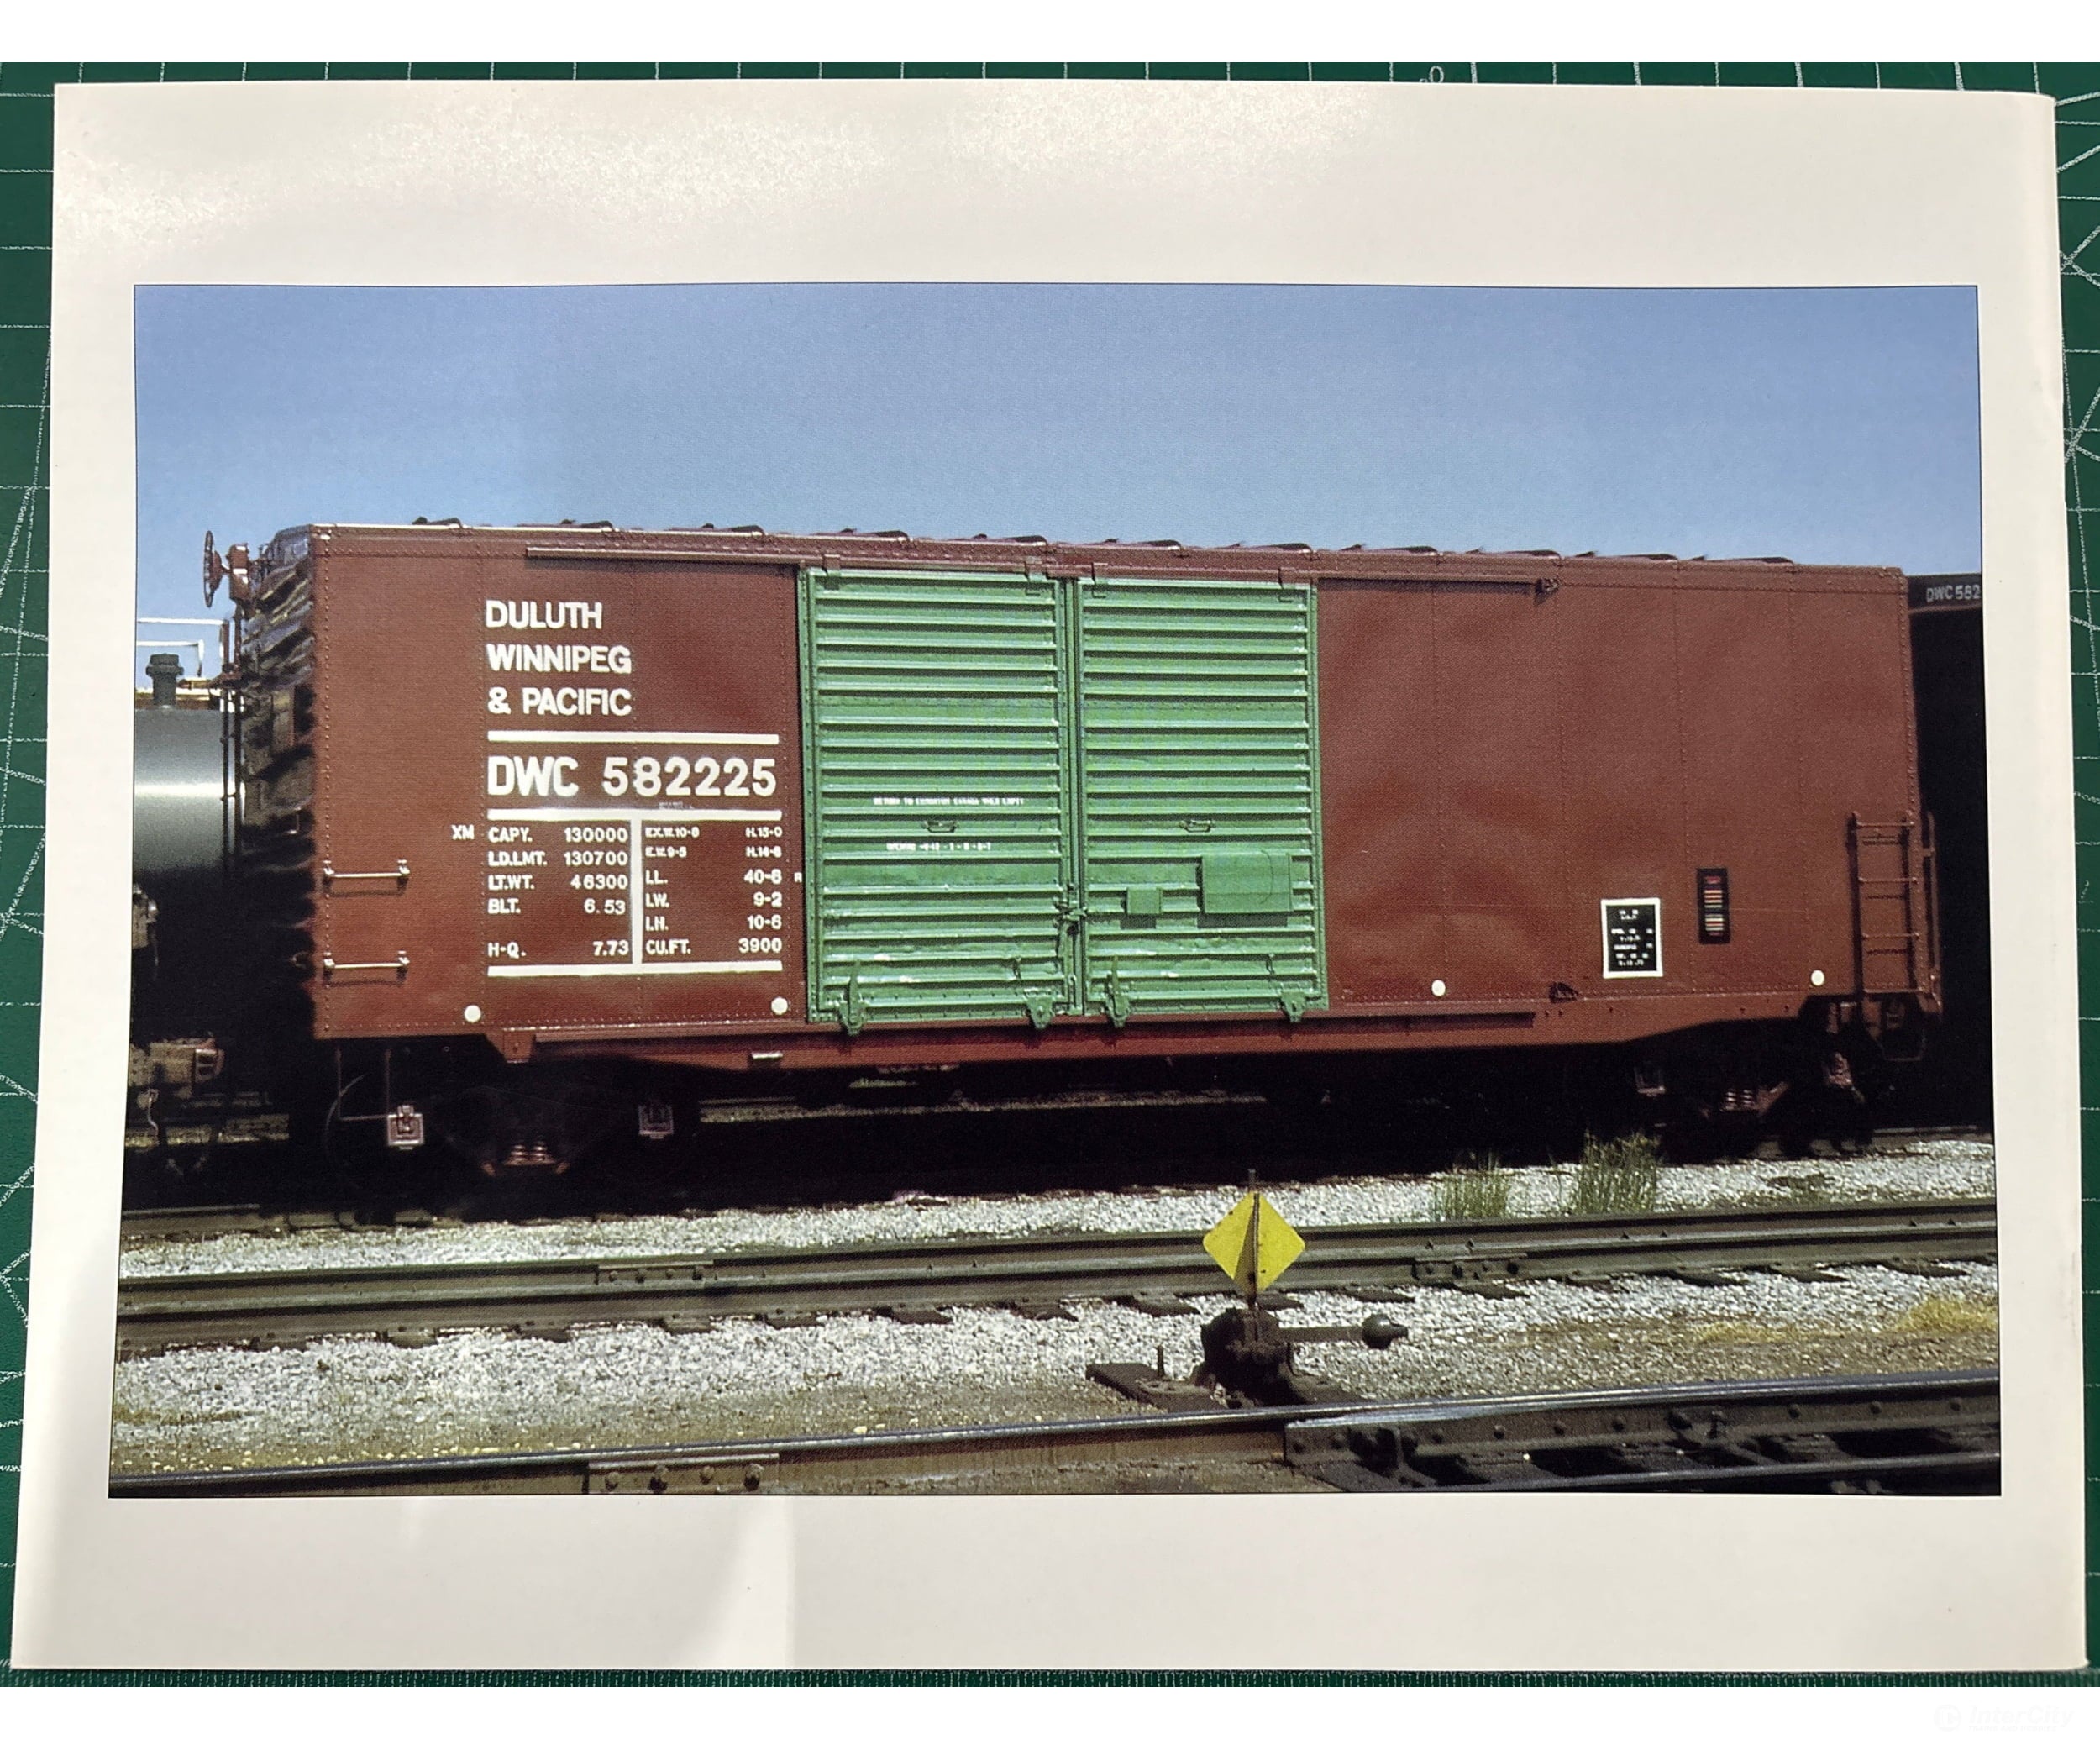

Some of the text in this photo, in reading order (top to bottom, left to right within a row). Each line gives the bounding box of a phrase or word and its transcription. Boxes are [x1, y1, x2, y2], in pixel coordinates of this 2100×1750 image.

[485, 599, 603, 629] DULUTH
[485, 644, 633, 675] WINNIPEG
[486, 686, 633, 716] & PACIFIC
[486, 755, 777, 797] DWC 582225
[450, 824, 475, 840] XM
[486, 826, 629, 843] CAPY. 130000
[563, 849, 629, 866] 130700
[487, 873, 629, 891] LT.WT. 46300
[486, 897, 522, 915] BLT.
[753, 891, 783, 908] 9-2
[592, 939, 630, 957] 7.73
[738, 937, 783, 954] 3900
